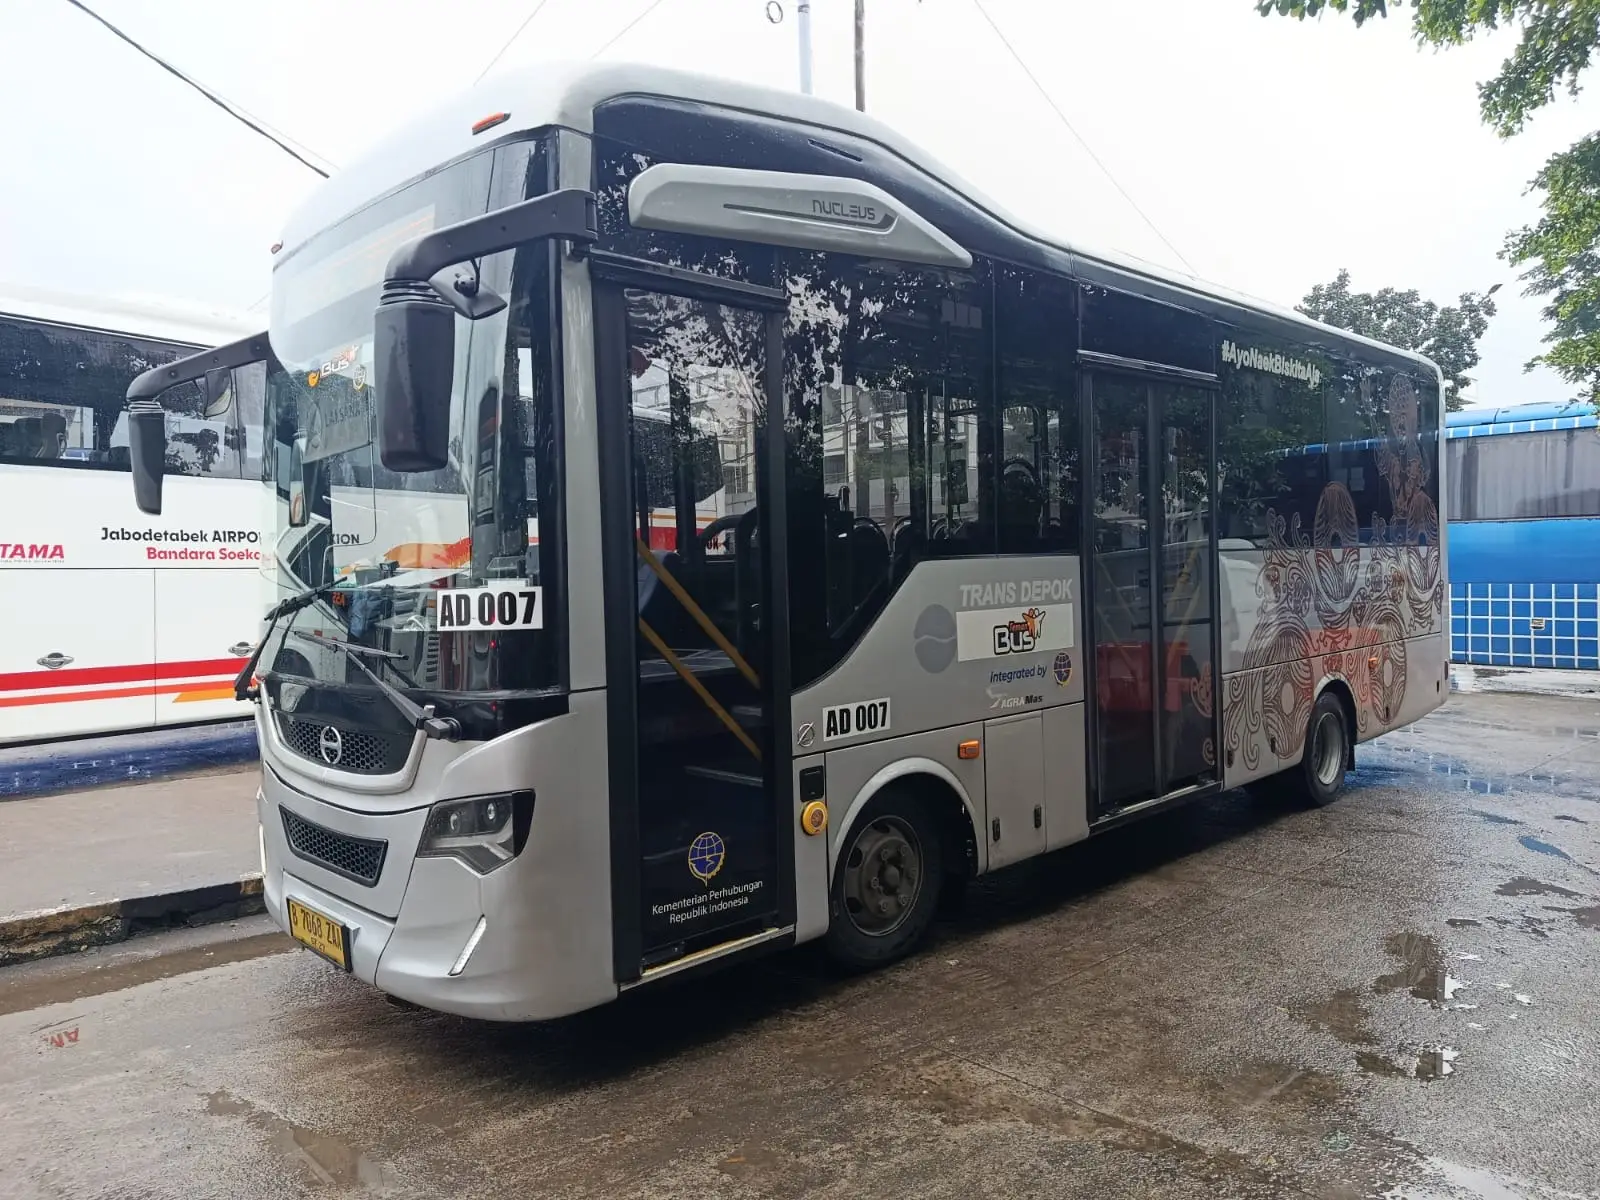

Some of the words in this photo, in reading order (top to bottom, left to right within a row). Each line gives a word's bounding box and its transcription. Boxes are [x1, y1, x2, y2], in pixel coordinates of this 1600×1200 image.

[101, 527, 208, 543] Jabodetabek
[0, 544, 64, 558] TAMA
[146, 547, 215, 560] Bandara
[960, 582, 1016, 607] TRANS
[1020, 579, 1072, 602] DEPOK
[440, 594, 471, 626] AD
[478, 591, 536, 626] 007
[1037, 664, 1047, 678] by
[826, 708, 851, 737] AD
[855, 702, 888, 730] 007
[652, 893, 707, 915] Kementerian
[709, 880, 763, 900] Perhubungan
[669, 907, 707, 923] Republik
[709, 896, 749, 913] Indonesia
